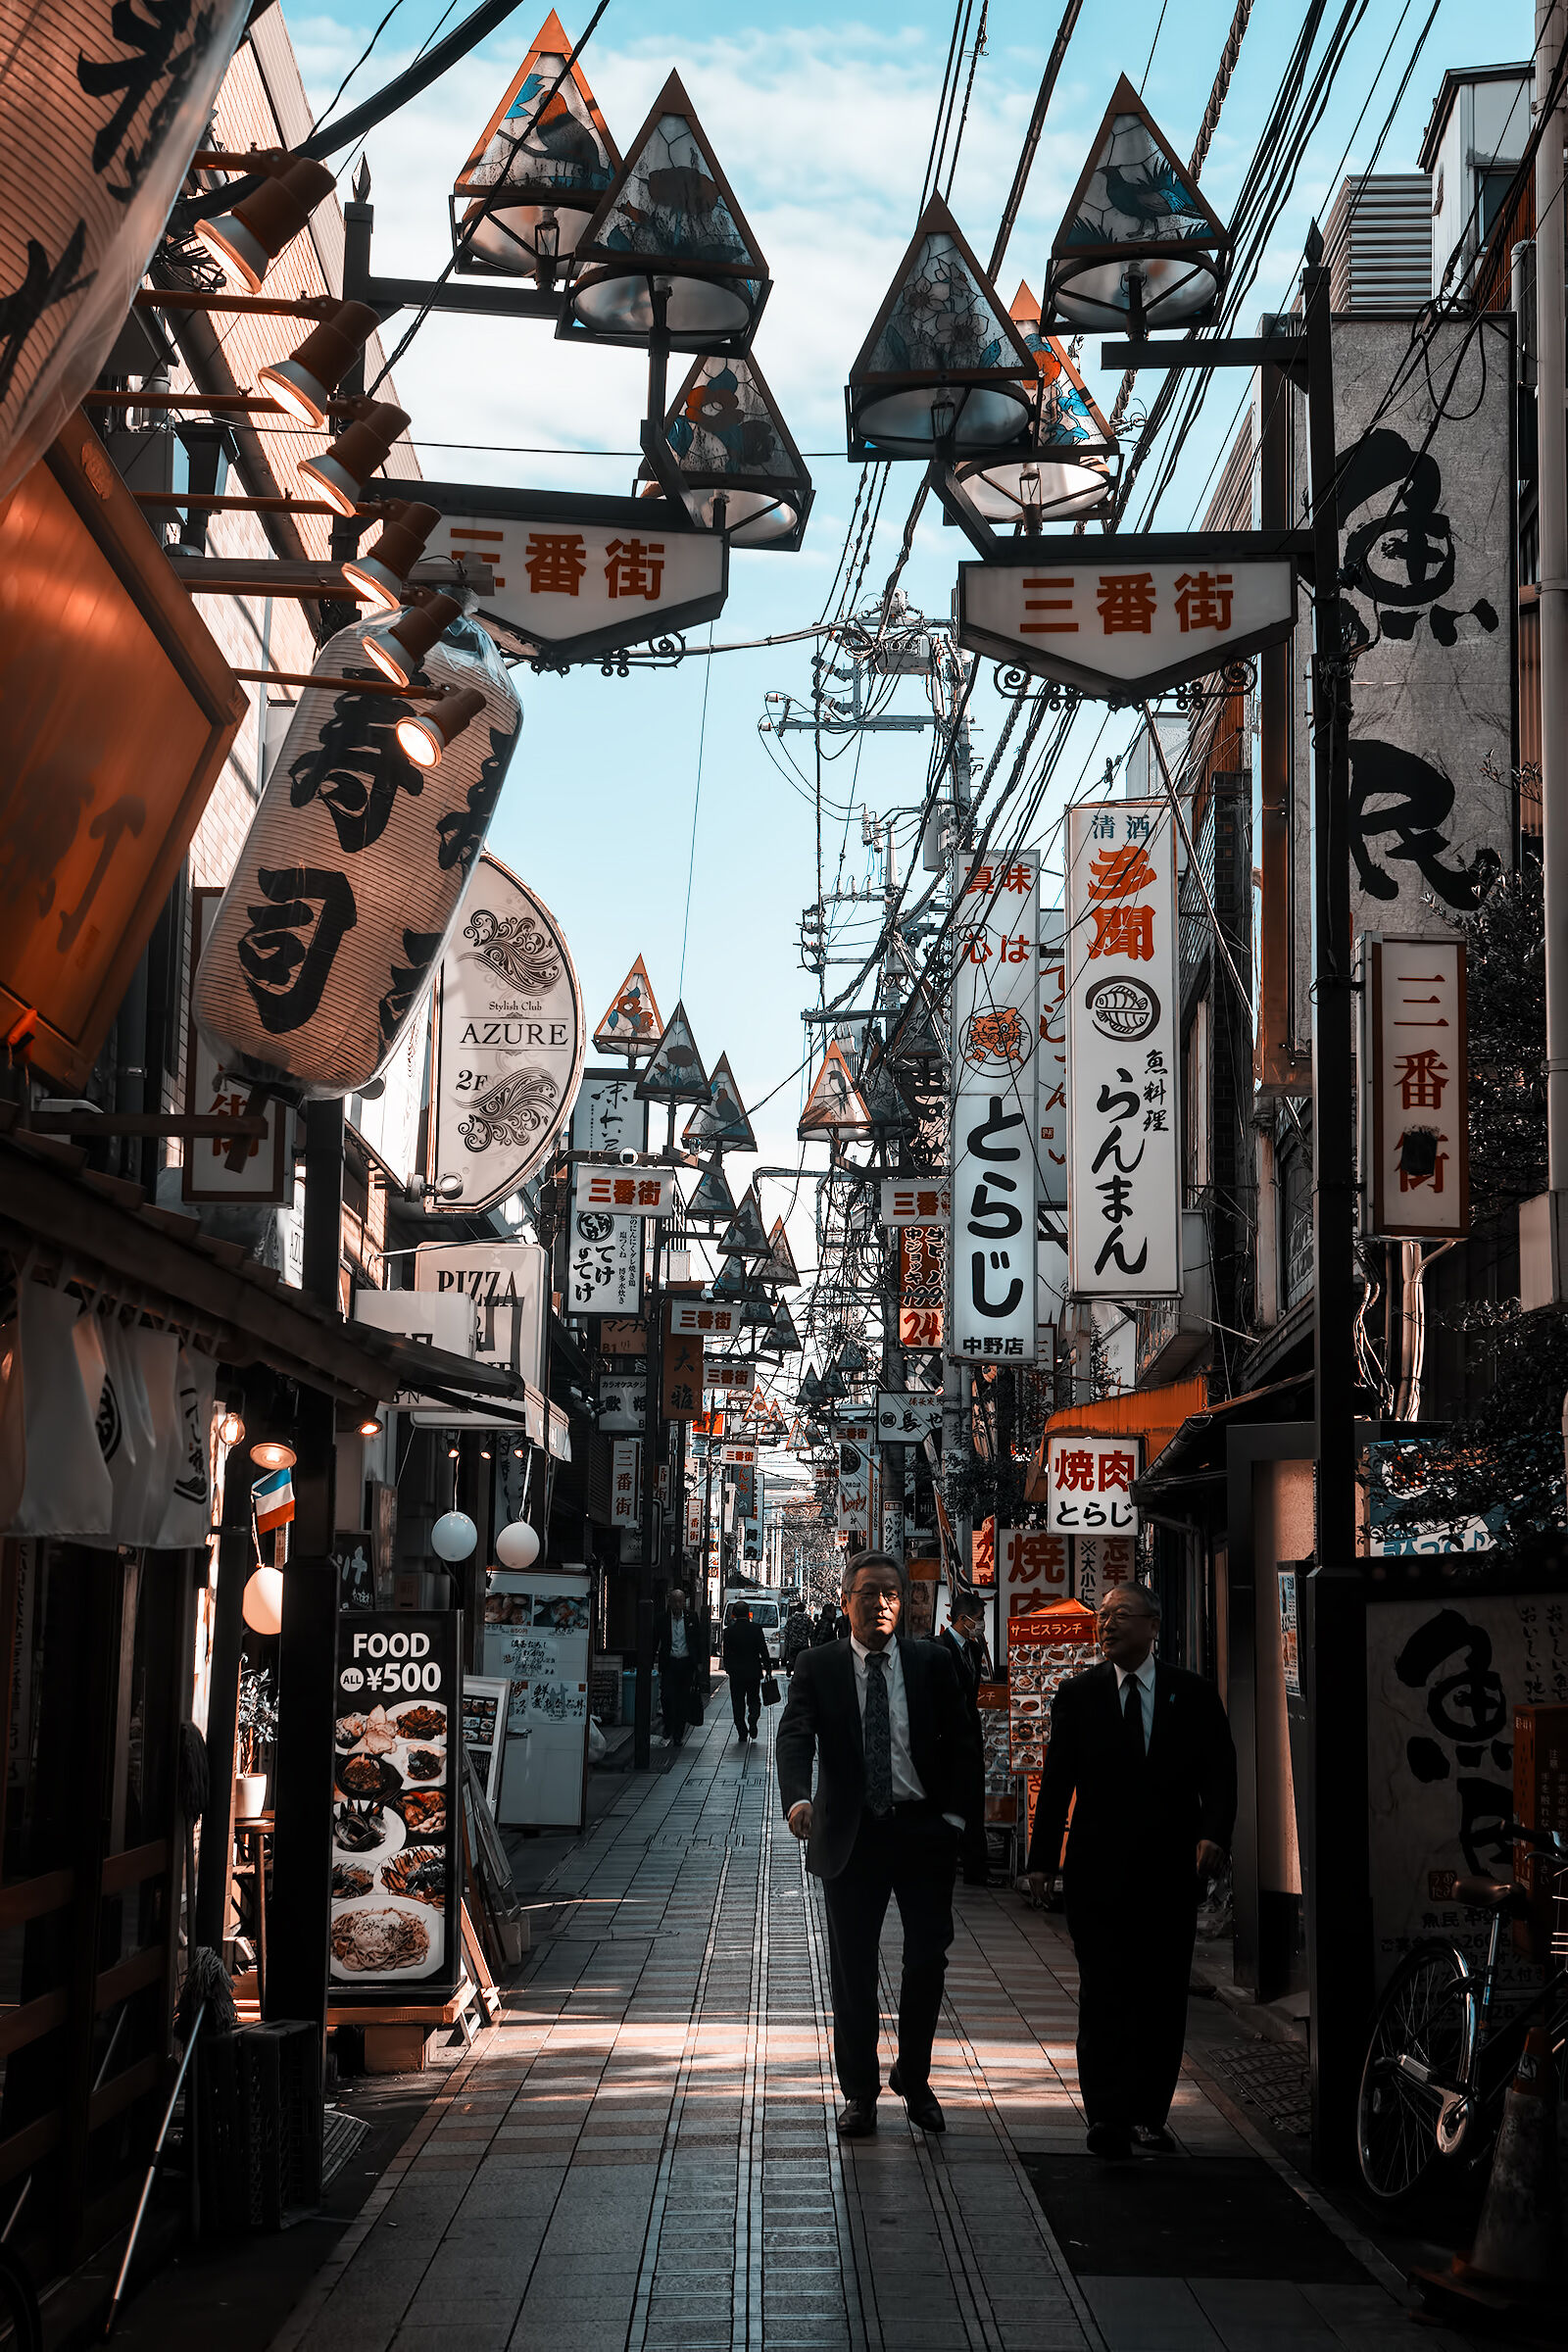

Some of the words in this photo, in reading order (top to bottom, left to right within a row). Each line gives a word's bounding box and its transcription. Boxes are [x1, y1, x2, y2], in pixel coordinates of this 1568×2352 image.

[450, 529, 665, 600] 三番街
[1019, 571, 1235, 636] 三番街
[1335, 427, 1499, 910] 魚民
[1092, 814, 1150, 840] 清酒
[964, 863, 1032, 894] 真味
[1087, 845, 1157, 961] 多聞
[488, 1000, 518, 1012] Stylish
[520, 1000, 543, 1011] Club
[460, 1023, 568, 1047] AZURE
[457, 1069, 489, 1092] 2F
[1143, 1050, 1169, 1132] 魚料理
[1091, 1067, 1148, 1276] らんまん
[589, 1179, 662, 1206] 三番街
[893, 1191, 950, 1216] 三番
[966, 1096, 1024, 1318] とらじ
[436, 1270, 521, 1307] PIZZA
[679, 1309, 732, 1331] 三番街
[902, 1311, 941, 1347] 24
[962, 1337, 1024, 1355] 中野店
[707, 1369, 749, 1386] 三番街
[836, 1427, 868, 1440] 三番街
[725, 1450, 755, 1462] 三番街
[616, 1449, 633, 1516] 三番街
[1055, 1449, 1135, 1493] 焼肉
[1056, 1500, 1134, 1528] とらじ
[1010, 1622, 1083, 1638] サービスランチ
[353, 1632, 431, 1658] FOOD
[342, 1675, 362, 1685] ALL
[366, 1662, 442, 1693] ¥500
